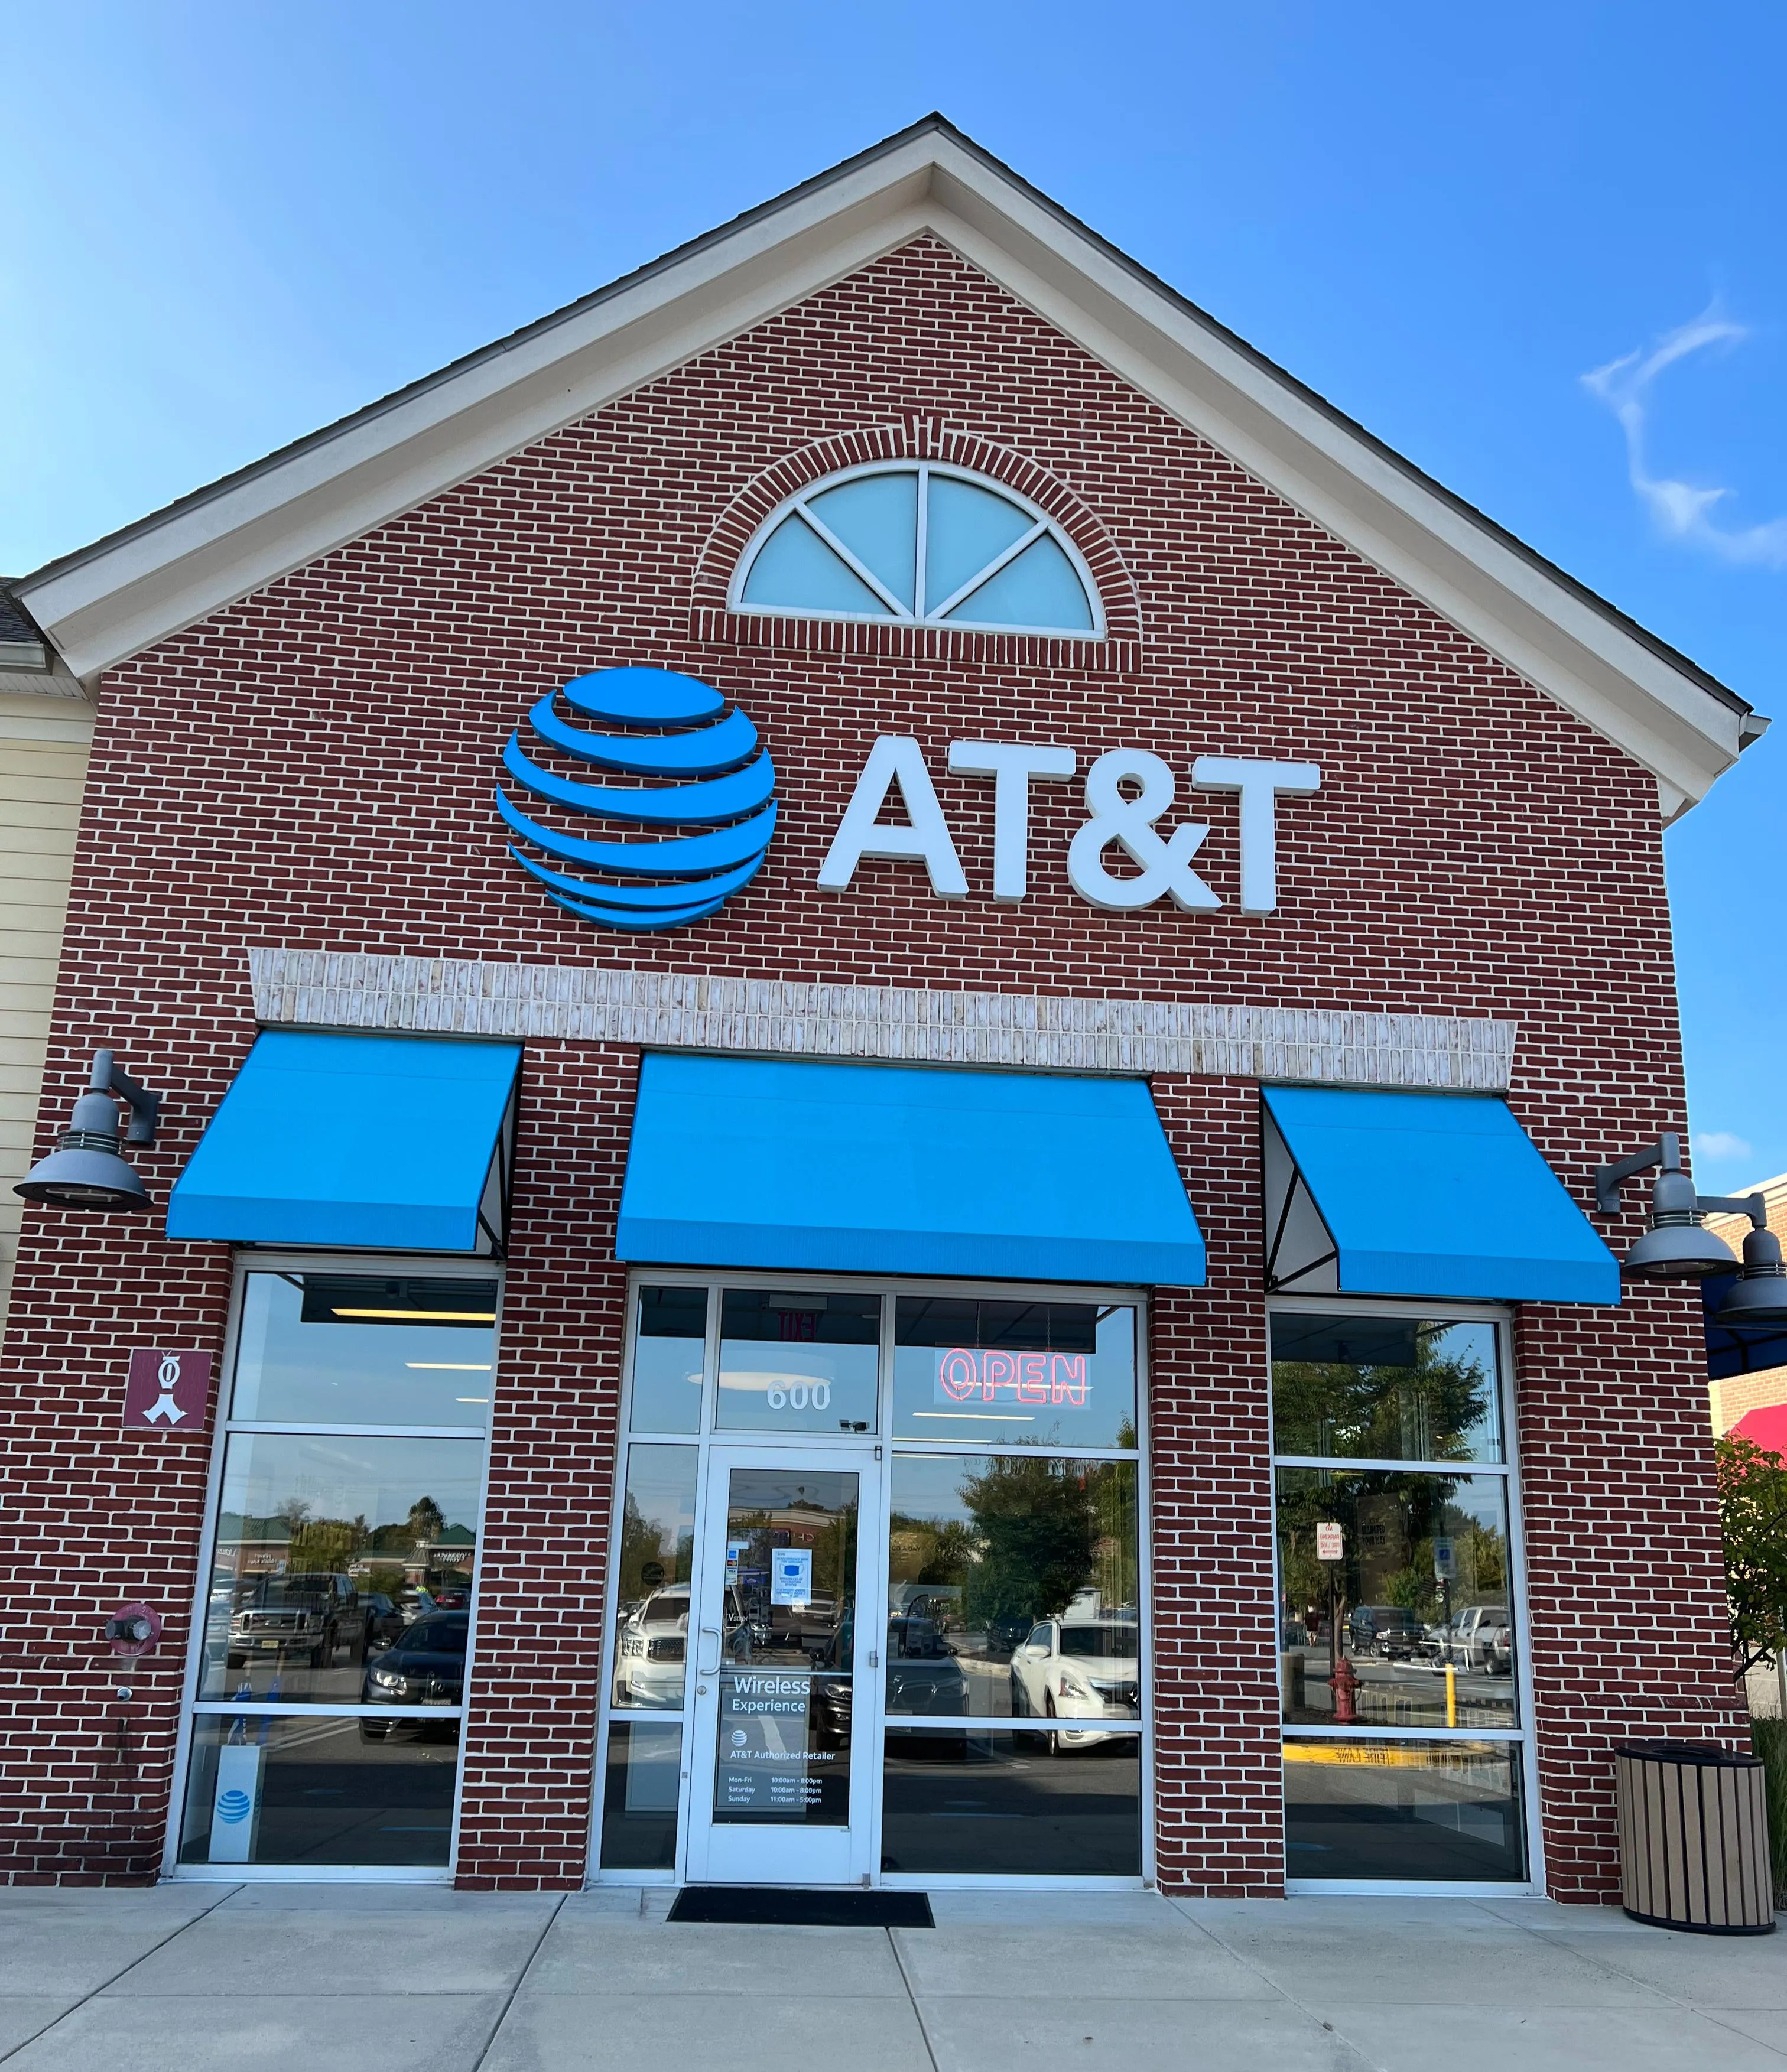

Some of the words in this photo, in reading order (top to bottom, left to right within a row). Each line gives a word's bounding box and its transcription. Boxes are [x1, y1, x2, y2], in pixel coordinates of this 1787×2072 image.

[817, 734, 1321, 917] AT&T
[940, 1348, 1086, 1405] OPEN
[767, 1380, 830, 1410] 600
[733, 1676, 810, 1694] Wireless
[732, 1699, 805, 1714] Experience
[730, 1751, 752, 1759] AT&T
[754, 1751, 801, 1759] Authorized
[802, 1751, 836, 1760] Retailer
[728, 1786, 756, 1794] Saturday
[728, 1795, 750, 1804] Sunday
